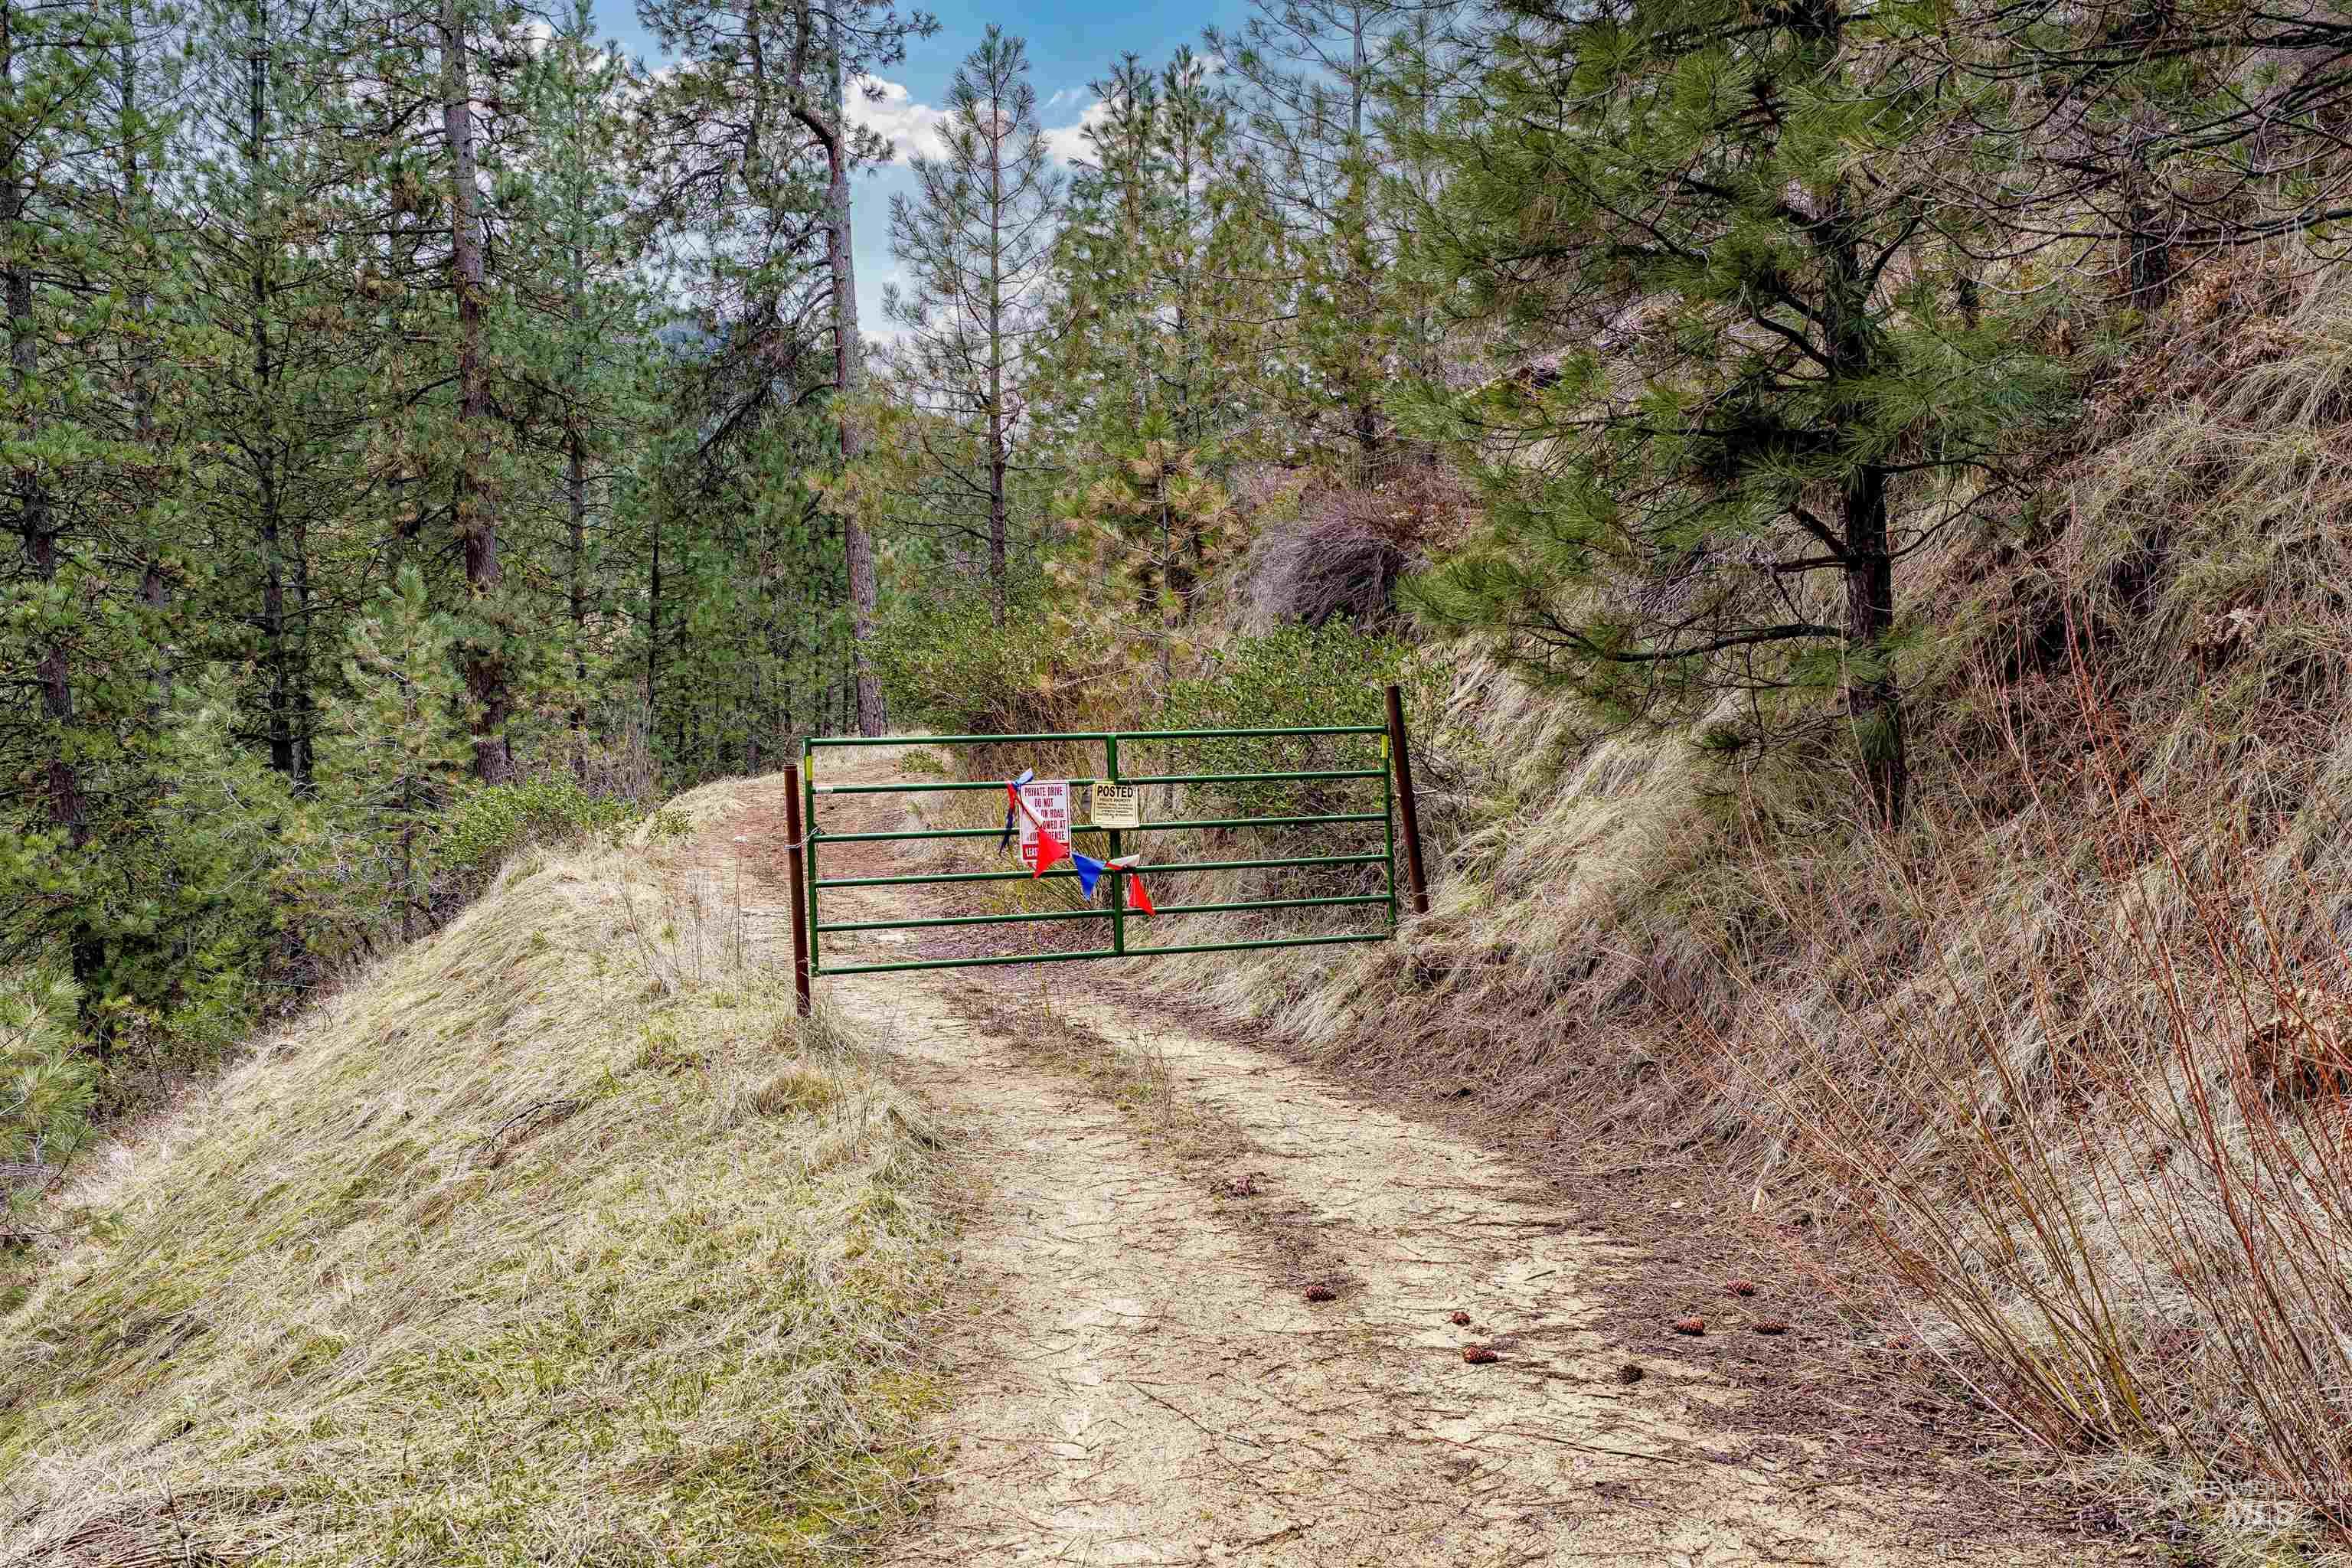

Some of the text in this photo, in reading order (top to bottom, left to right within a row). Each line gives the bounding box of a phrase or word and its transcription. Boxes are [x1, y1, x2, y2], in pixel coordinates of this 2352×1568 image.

[1024, 786, 1063, 797] PRIVATE DRIVE
[1097, 785, 1133, 798] POSTED
[1034, 798, 1054, 808] DO NOT
[1041, 808, 1064, 818] ON ROAD
[1042, 820, 1067, 830] OWED AT
